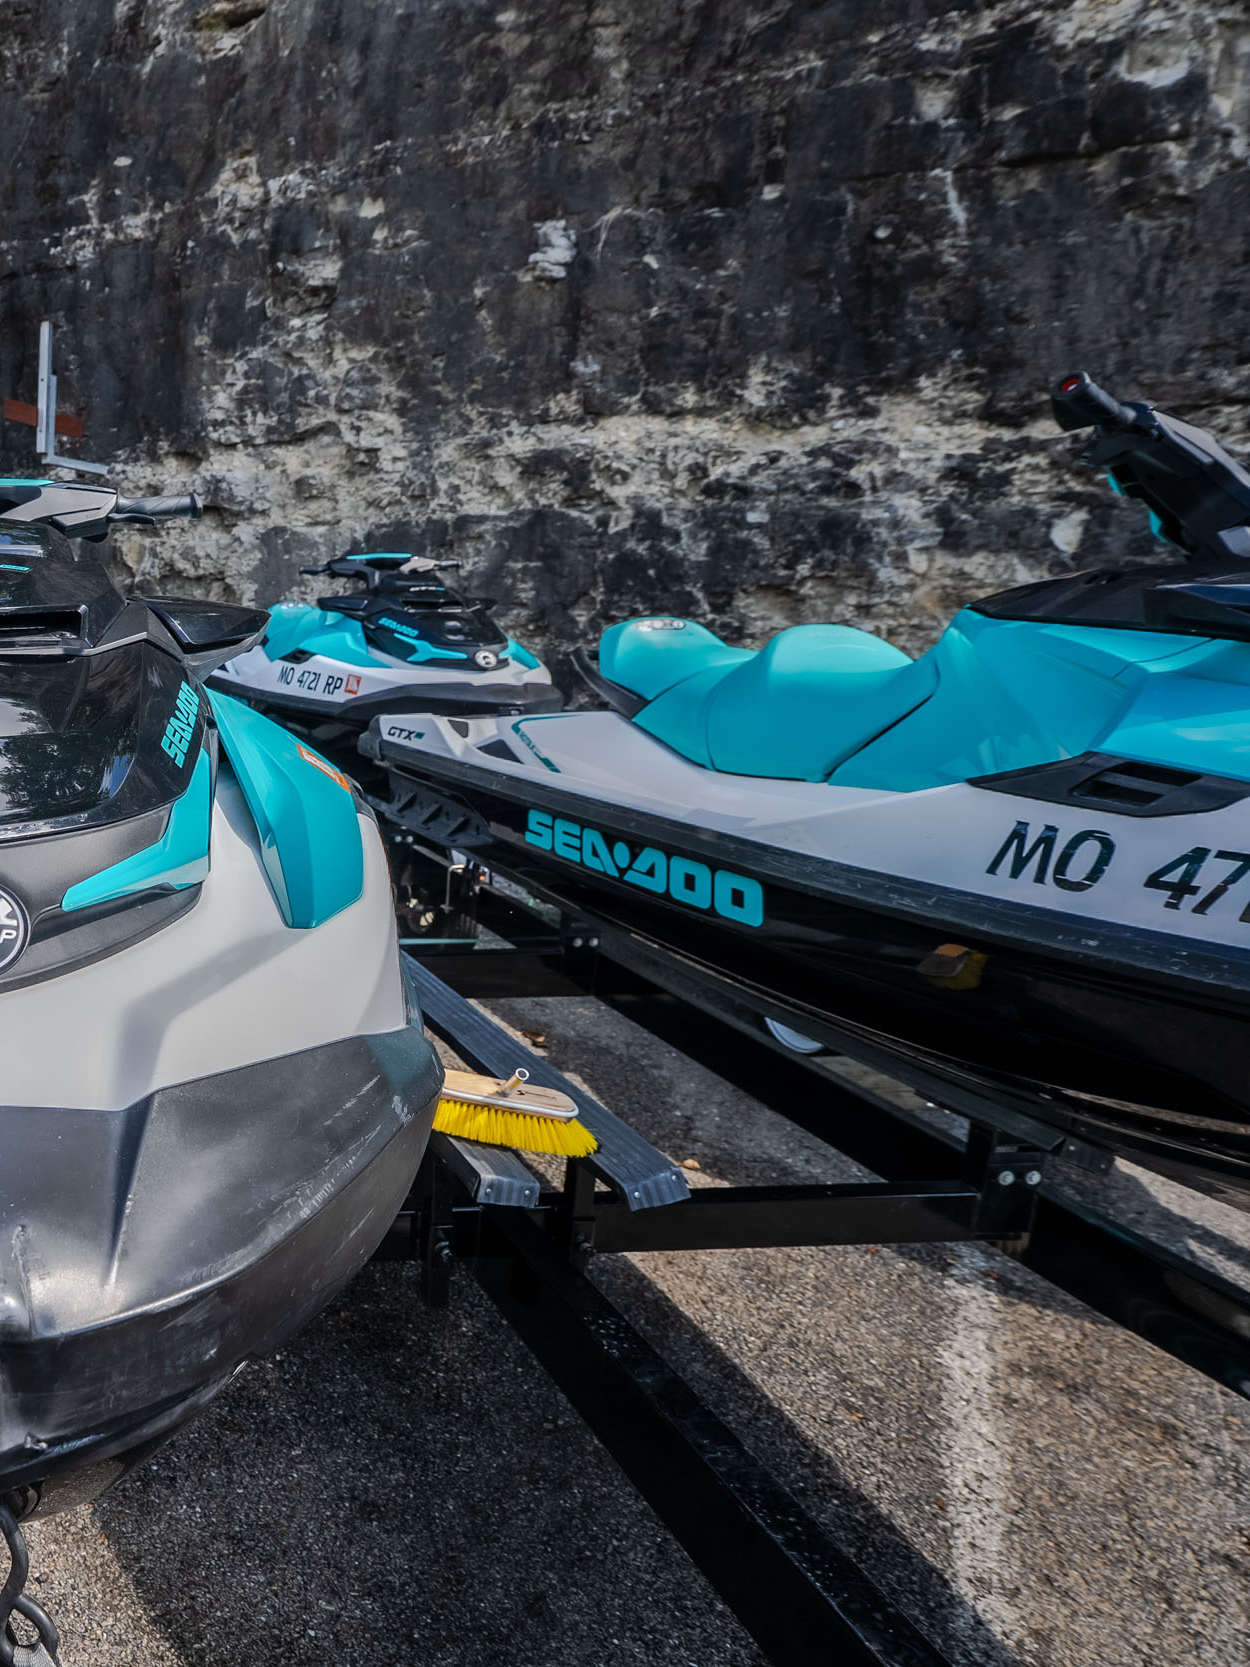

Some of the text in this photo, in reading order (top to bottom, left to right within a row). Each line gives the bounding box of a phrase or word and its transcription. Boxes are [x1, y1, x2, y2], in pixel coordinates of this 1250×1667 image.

[277, 665, 295, 685] MO
[297, 670, 321, 691] 4721
[323, 675, 344, 695] RP
[387, 726, 415, 741] GTX
[984, 819, 1250, 924] MO 47
